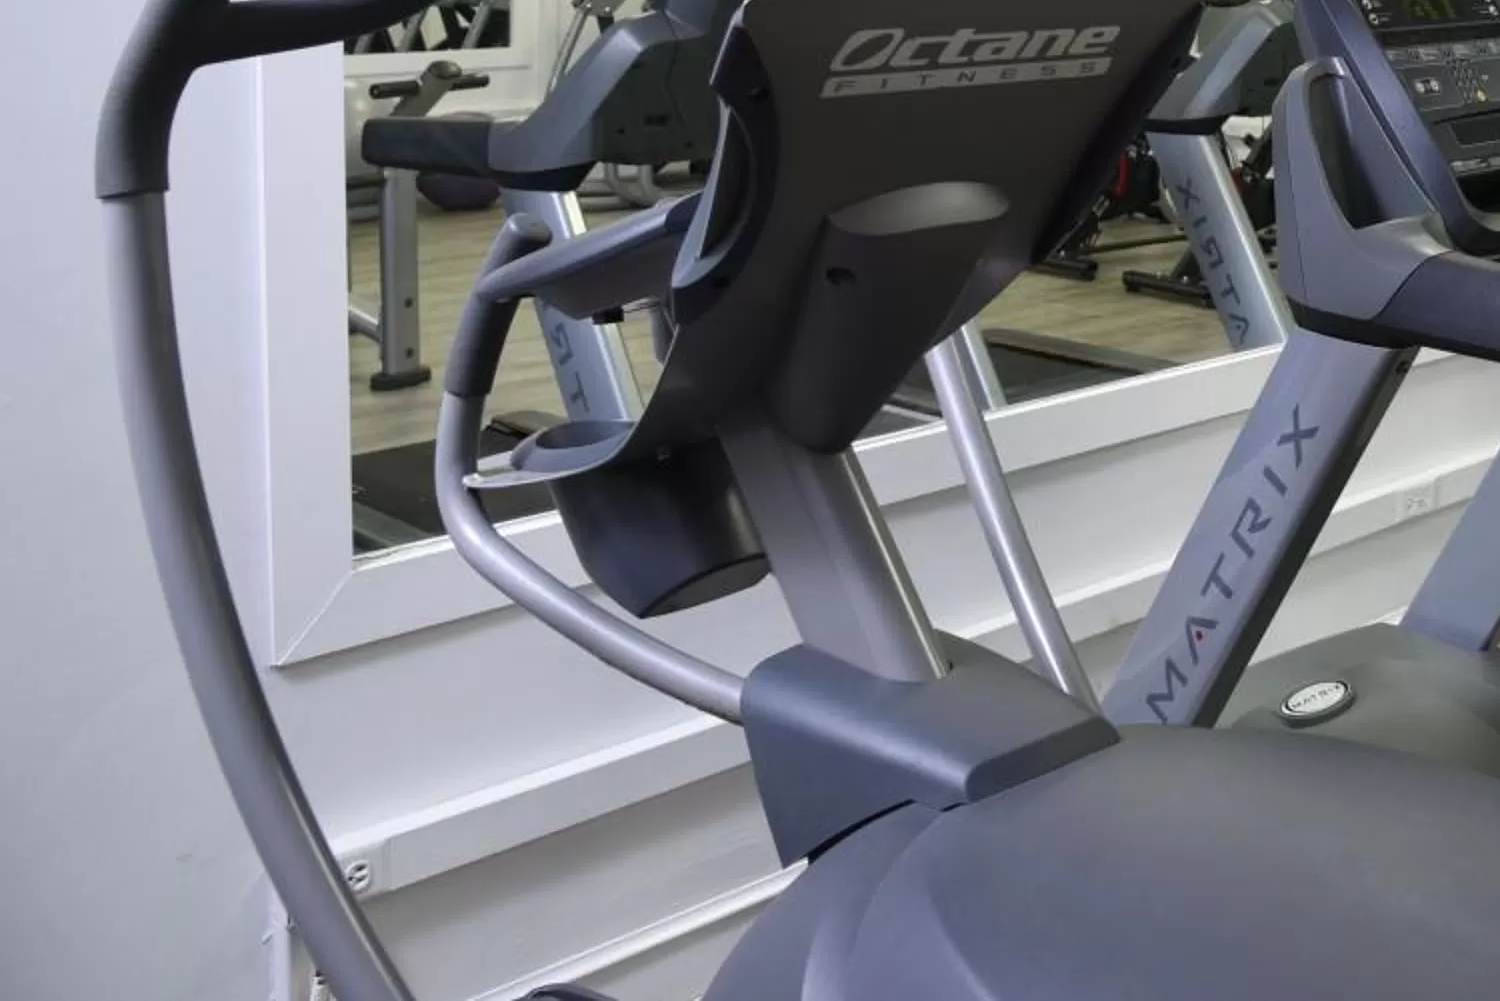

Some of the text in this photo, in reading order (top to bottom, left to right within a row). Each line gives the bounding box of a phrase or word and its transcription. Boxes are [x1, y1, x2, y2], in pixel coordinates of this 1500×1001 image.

[829, 26, 1121, 72] Octane
[833, 61, 1098, 94] FITNESS
[1146, 403, 1320, 726] MATRIX
